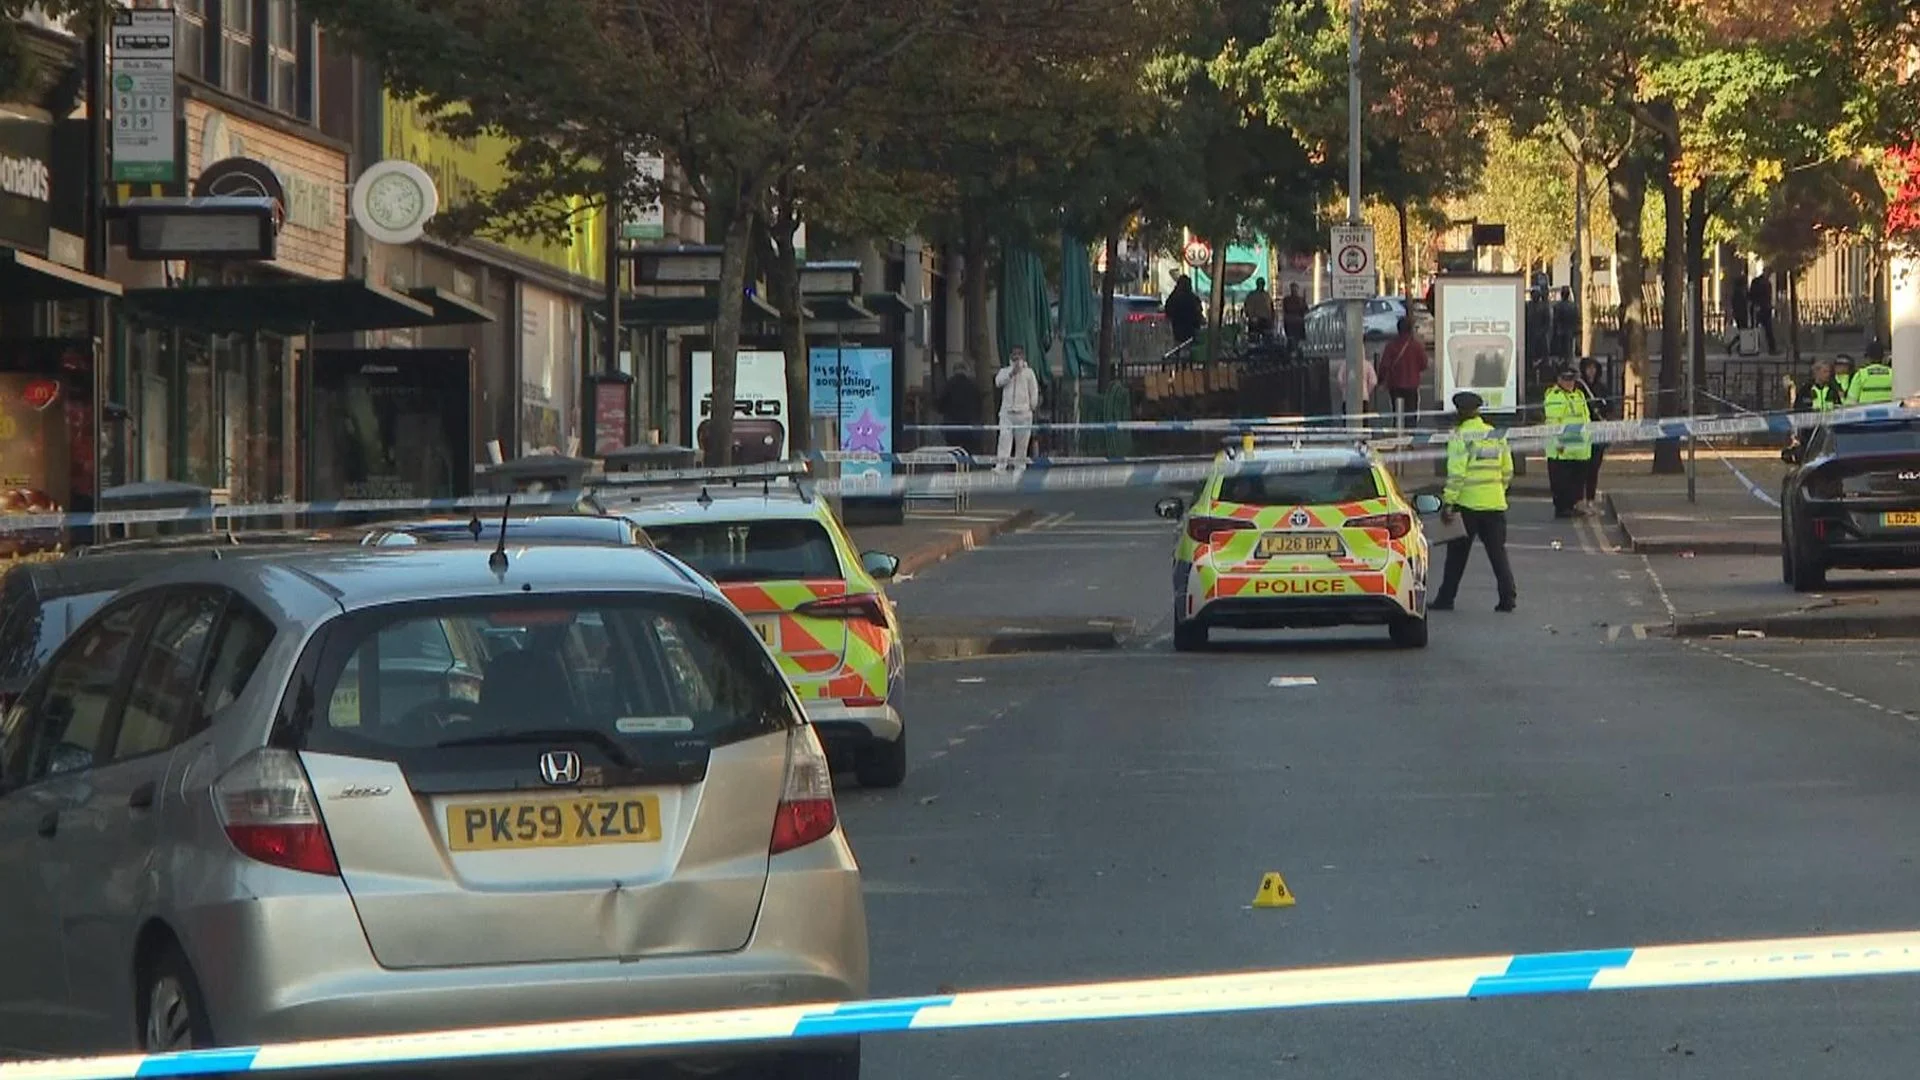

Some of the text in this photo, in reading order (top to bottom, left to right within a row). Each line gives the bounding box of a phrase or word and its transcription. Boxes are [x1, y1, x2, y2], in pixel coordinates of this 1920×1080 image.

[1449, 321, 1510, 333] PRO
[816, 376, 871, 388] somthing
[1255, 579, 1346, 593] POLICE
[465, 800, 646, 844] PK59 XZO
